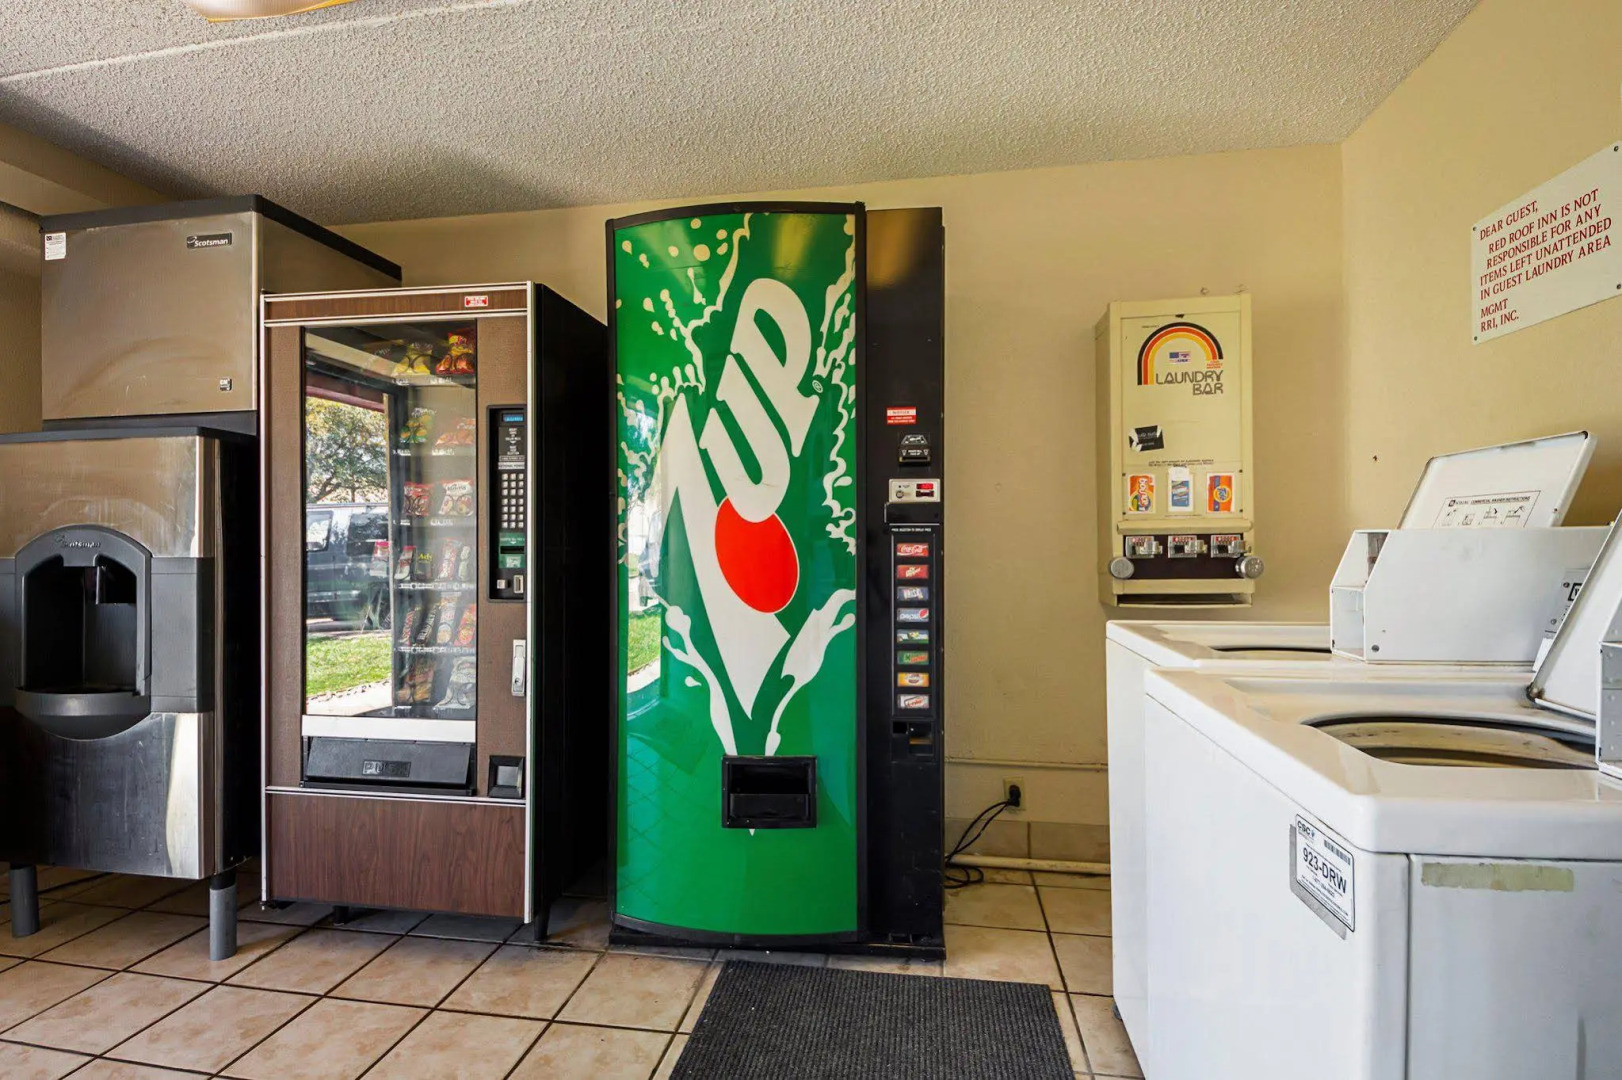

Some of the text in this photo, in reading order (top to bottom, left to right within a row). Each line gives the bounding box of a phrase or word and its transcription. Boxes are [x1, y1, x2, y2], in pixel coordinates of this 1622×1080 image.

[1479, 200, 1539, 240] DEAR GUEST,
[1488, 188, 1599, 254] RED ROOF INN IS NOT
[194, 239, 229, 247] Scotsman
[1480, 217, 1612, 287] ITEMS LEFT UNATTENDED
[1486, 203, 1602, 270] RESPONSIBLE FOR ANY
[1480, 235, 1611, 300] IN GUEST LAUNDRY AREA
[1480, 298, 1508, 319] MGMT
[1480, 309, 1520, 333] RRI, INC.
[1155, 370, 1224, 385] LAUNDRY
[1192, 383, 1224, 396] BAR
[1297, 820, 1311, 836] CSC
[1302, 847, 1347, 894] 923-DRW
